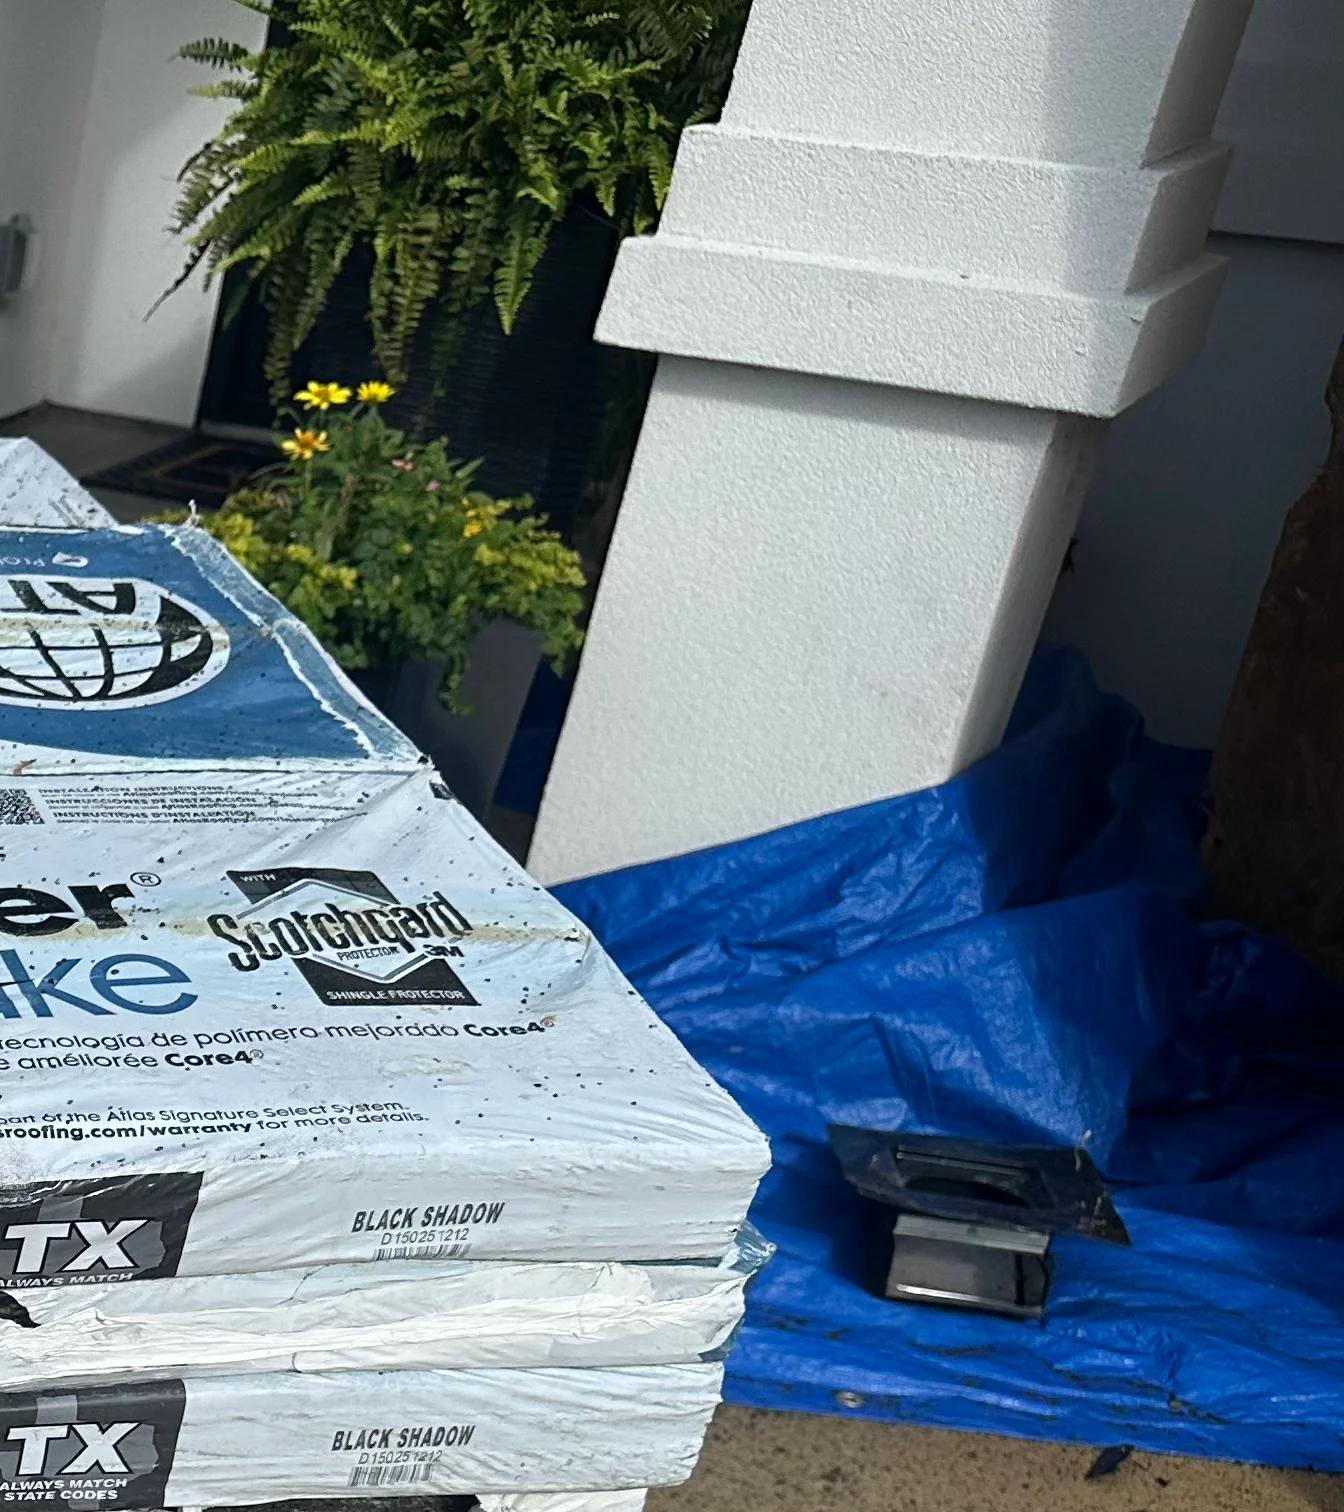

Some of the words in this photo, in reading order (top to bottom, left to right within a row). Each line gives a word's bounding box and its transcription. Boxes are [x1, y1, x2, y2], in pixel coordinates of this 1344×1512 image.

[239, 873, 277, 882] WITH
[207, 891, 473, 972] Scotchgard
[336, 946, 401, 961] PROTECTOR
[421, 944, 466, 957] 3M
[325, 991, 389, 1000] SHINGLE
[392, 990, 468, 1000] PROTECTOR
[152, 1033, 188, 1047] de
[195, 1028, 317, 1049] polímero
[325, 1023, 461, 1040] mejorado
[18, 1053, 159, 1069] améliorée
[42, 1113, 63, 1121] of
[66, 1112, 101, 1122] the
[107, 1110, 157, 1121] Atlas
[160, 1109, 260, 1123] Signature
[262, 1106, 328, 1118] Select
[256, 1120, 289, 1130] for
[293, 1116, 352, 1127] more
[352, 1206, 414, 1234] BLACK
[418, 1201, 506, 1227] SHADOW
[4, 1218, 149, 1274] TX
[63, 1272, 134, 1284] MATCH
[331, 1429, 395, 1453] BLACK
[398, 1424, 477, 1447] SHADOW
[7, 1421, 141, 1475] TX
[69, 1477, 129, 1489] MATCH
[3, 1491, 56, 1501] STATE
[60, 1490, 119, 1500] CODES
